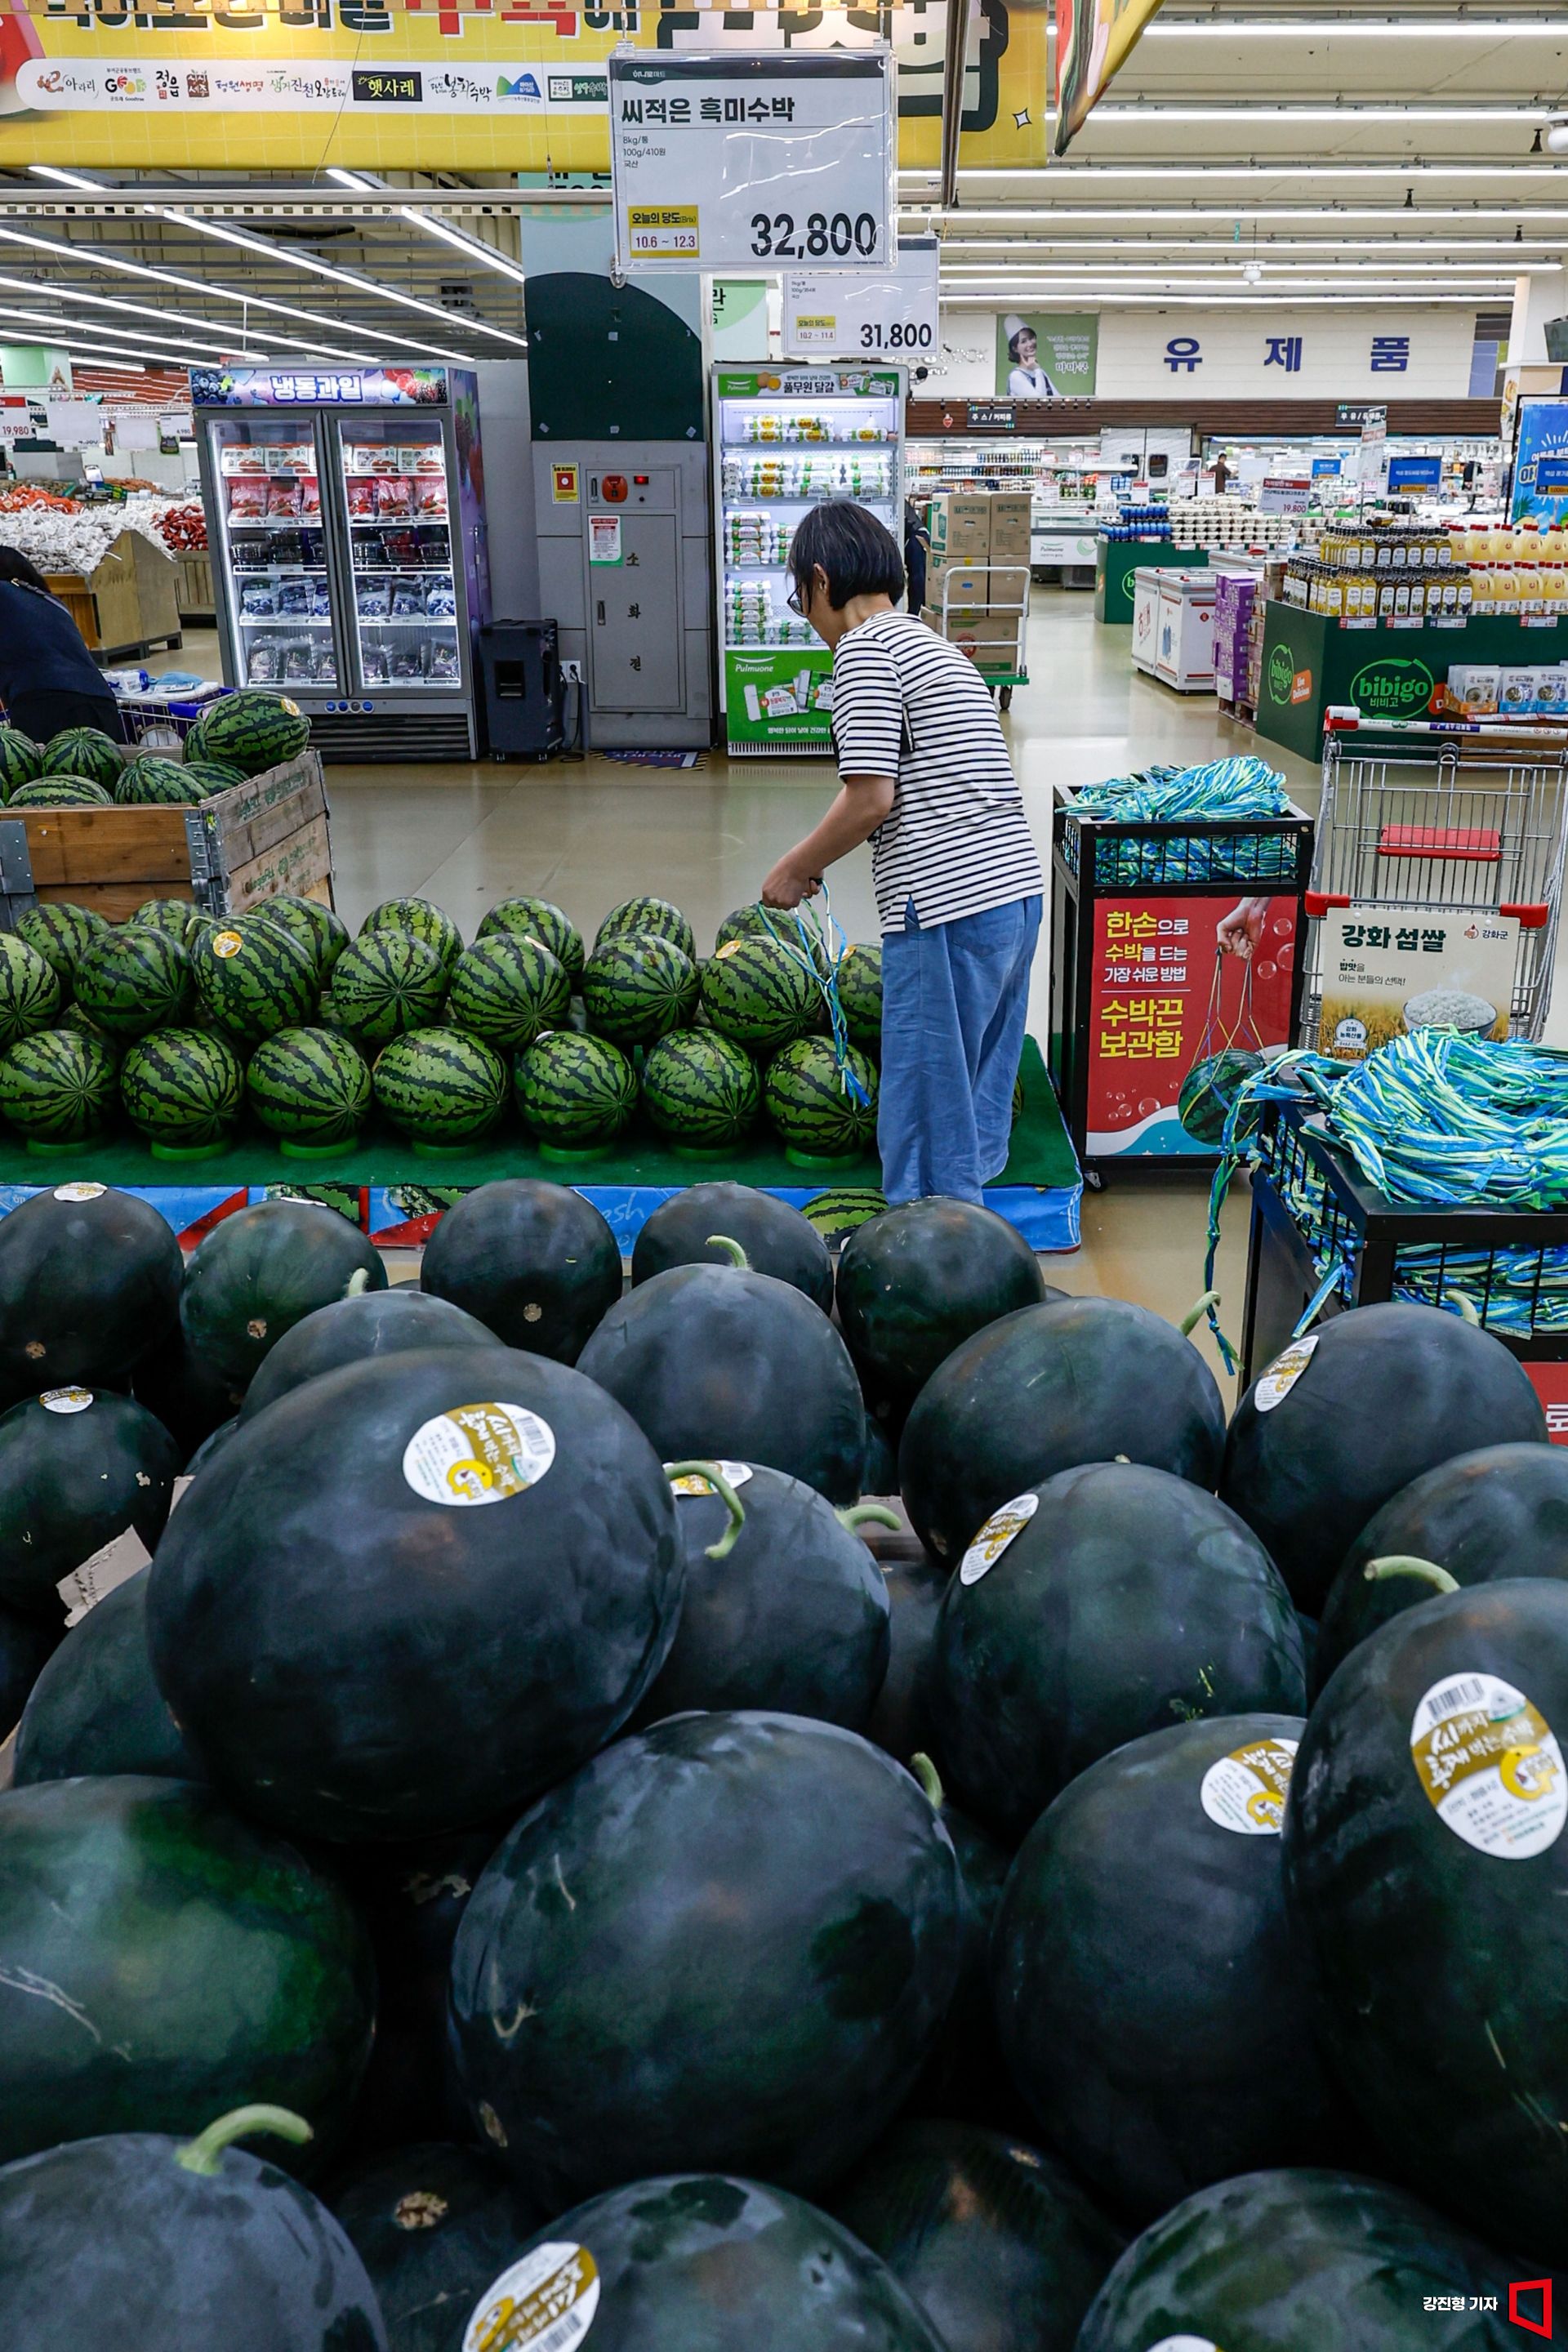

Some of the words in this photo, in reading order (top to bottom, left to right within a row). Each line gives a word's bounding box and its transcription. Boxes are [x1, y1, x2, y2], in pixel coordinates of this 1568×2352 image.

[632, 70, 666, 78] 하나로마트
[156, 69, 179, 97] 정읍
[215, 79, 264, 92] 청원생명
[368, 78, 415, 98] 햇사레
[621, 98, 692, 123] 씨적은
[699, 96, 795, 122] 흑미수박
[623, 136, 648, 145] 8kg/통
[623, 148, 666, 158] 100g/410원
[623, 160, 639, 168] 국산
[632, 213, 660, 225] 오늘의
[635, 235, 657, 248] 10.6
[674, 235, 696, 247] 12.3
[751, 212, 877, 260] 32,800
[860, 323, 932, 350] 31,800
[1055, 361, 1089, 375] 마마쿡
[270, 375, 363, 402] 냉동과일
[784, 381, 813, 394] 풀무원
[815, 381, 835, 394] 달걀
[2, 425, 29, 435] 19,980
[1283, 503, 1307, 513] 19,800
[735, 664, 773, 672] Pulmuone
[1271, 659, 1292, 688] bibigo
[1359, 675, 1428, 702] bibigo
[1370, 697, 1399, 708] 비비고
[1106, 911, 1189, 939] 한손으로
[1341, 924, 1391, 949] 강화
[1395, 928, 1446, 953] 섬쌀
[1482, 929, 1508, 940] 강화군
[1104, 943, 1156, 962] 수박을
[1159, 946, 1187, 961] 드는
[1104, 967, 1131, 982] 가장
[1132, 967, 1158, 982] 쉬운
[1160, 966, 1187, 982] 방법
[1339, 961, 1365, 973] 밥맛을
[1339, 974, 1356, 983] 아는
[1357, 974, 1383, 985] 분들의
[1385, 976, 1405, 987] 선택!
[1100, 999, 1183, 1028] 수박끈
[1099, 1031, 1183, 1058] 보관함
[602, 1192, 644, 1223] esh
